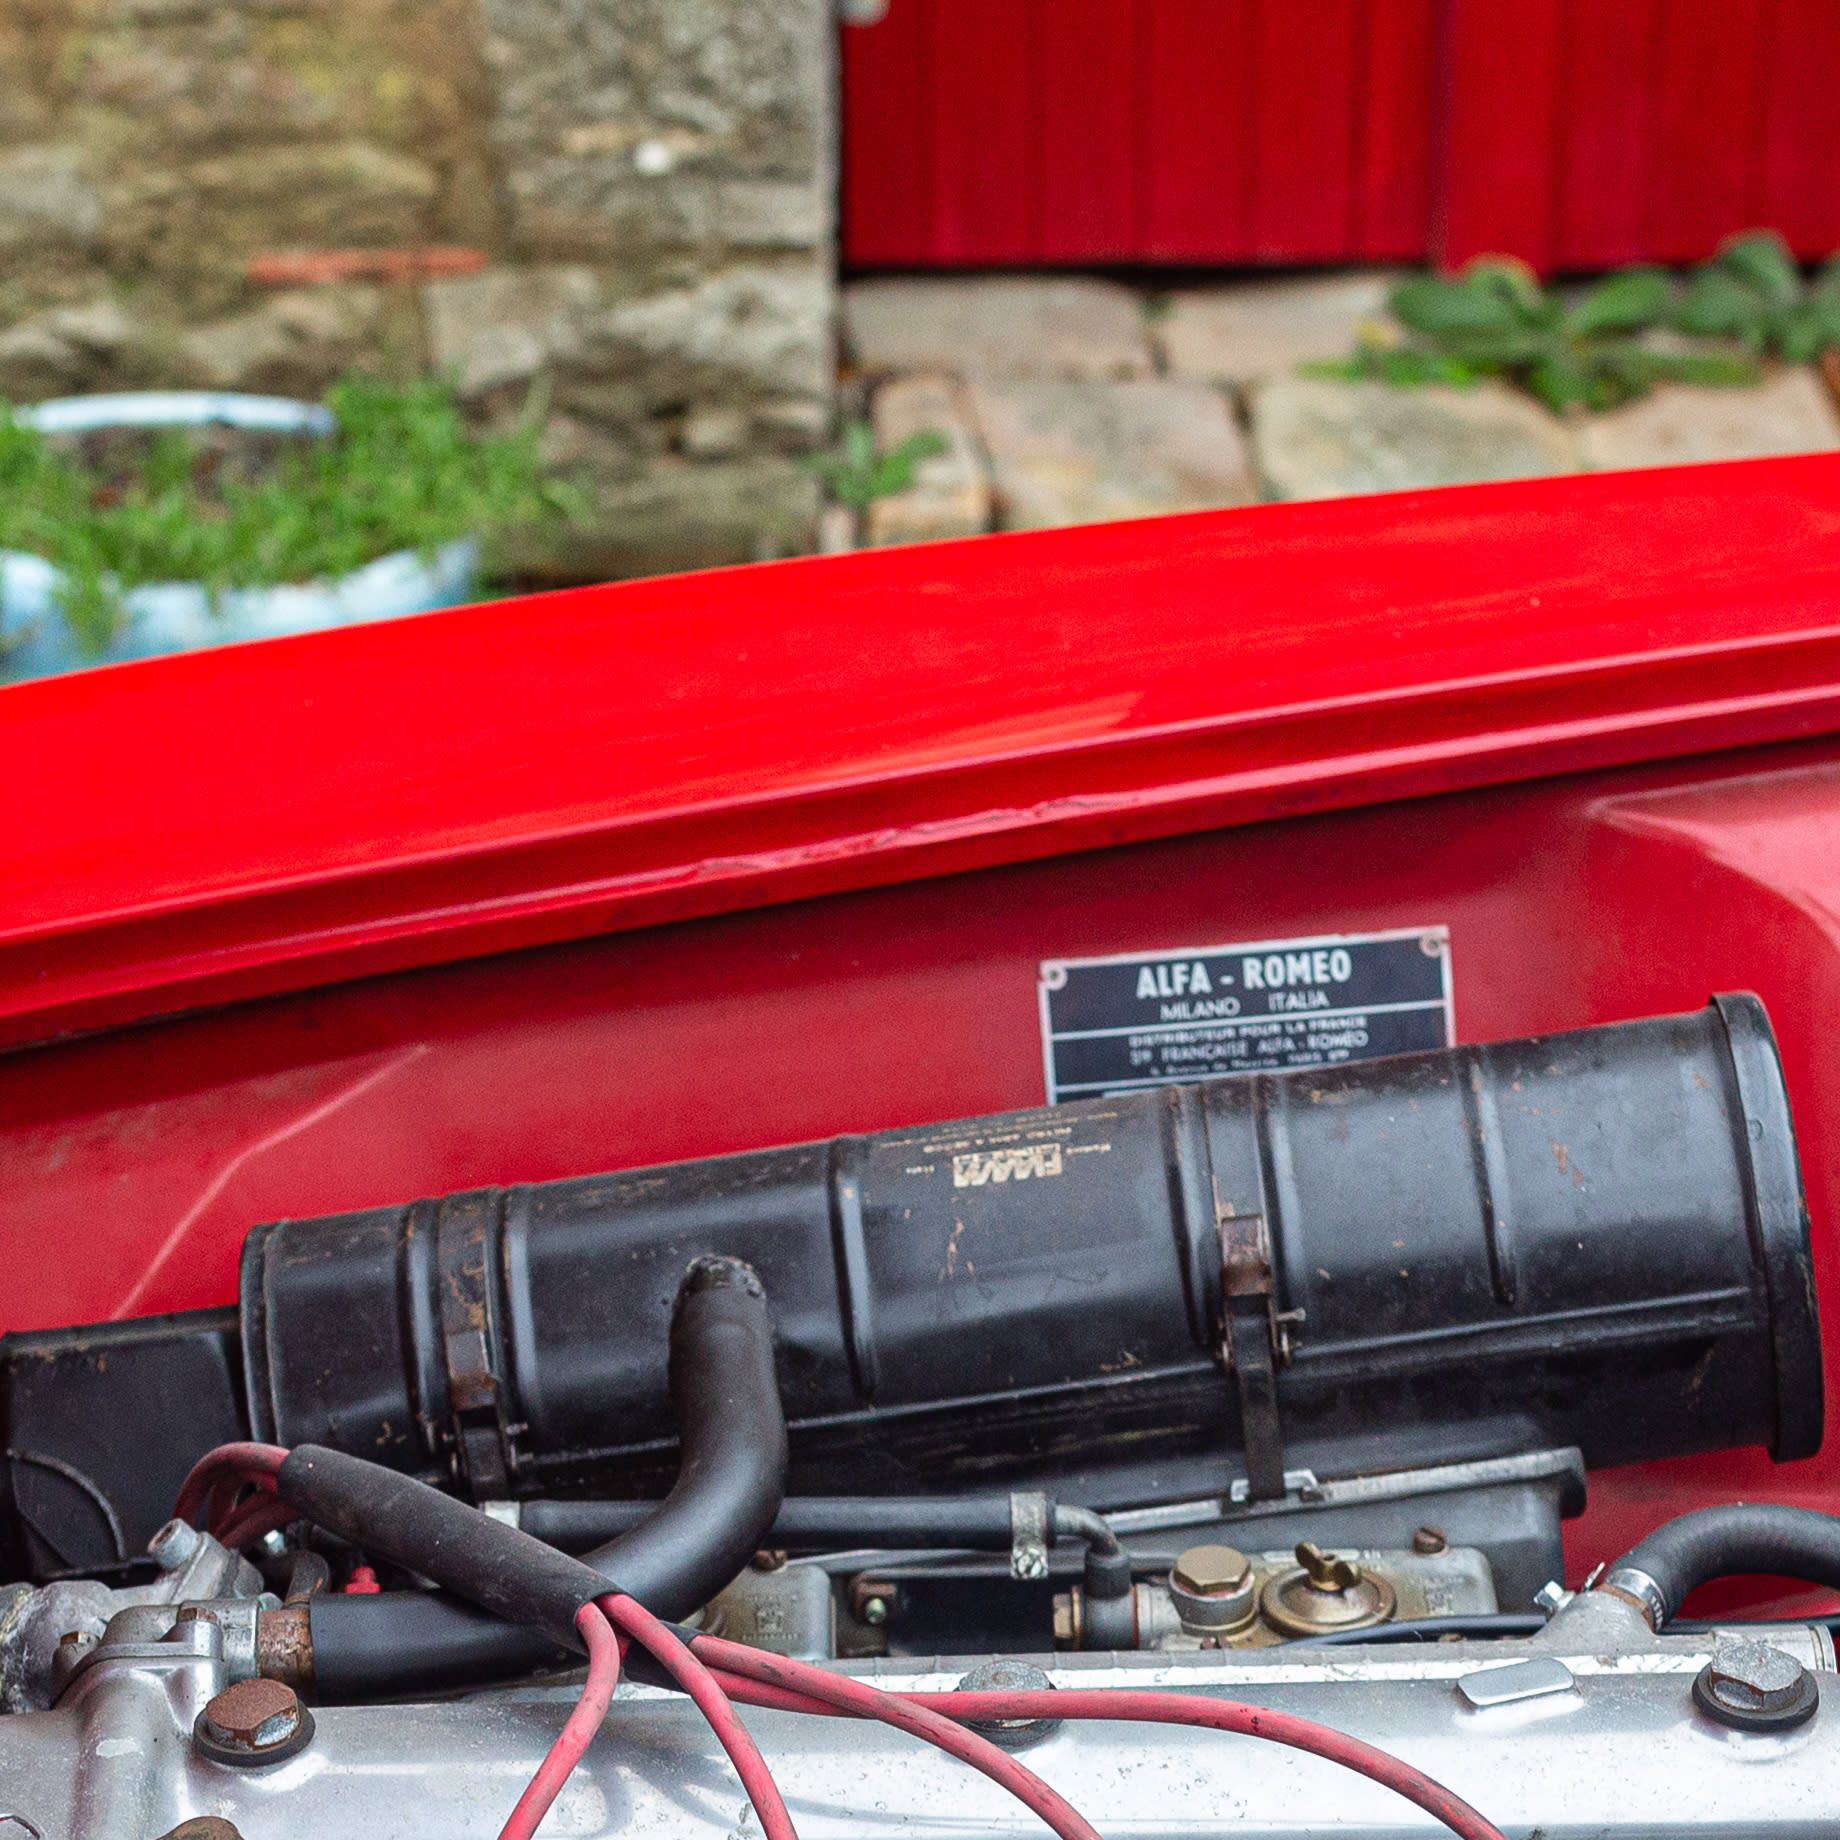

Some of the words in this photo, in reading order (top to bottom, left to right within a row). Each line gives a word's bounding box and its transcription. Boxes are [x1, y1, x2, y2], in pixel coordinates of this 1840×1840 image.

[1136, 961, 1213, 999] ALFA
[1242, 949, 1352, 989] ROMEO
[1160, 996, 1241, 1020] MILANO
[1268, 991, 1330, 1011] ITALIA
[1239, 1021, 1282, 1039] POUR
[1286, 1018, 1306, 1033] LA
[1256, 1037, 1297, 1054] ALFA
[1307, 1030, 1369, 1050] ROMEO
[953, 1152, 1062, 1187] FIAAM
